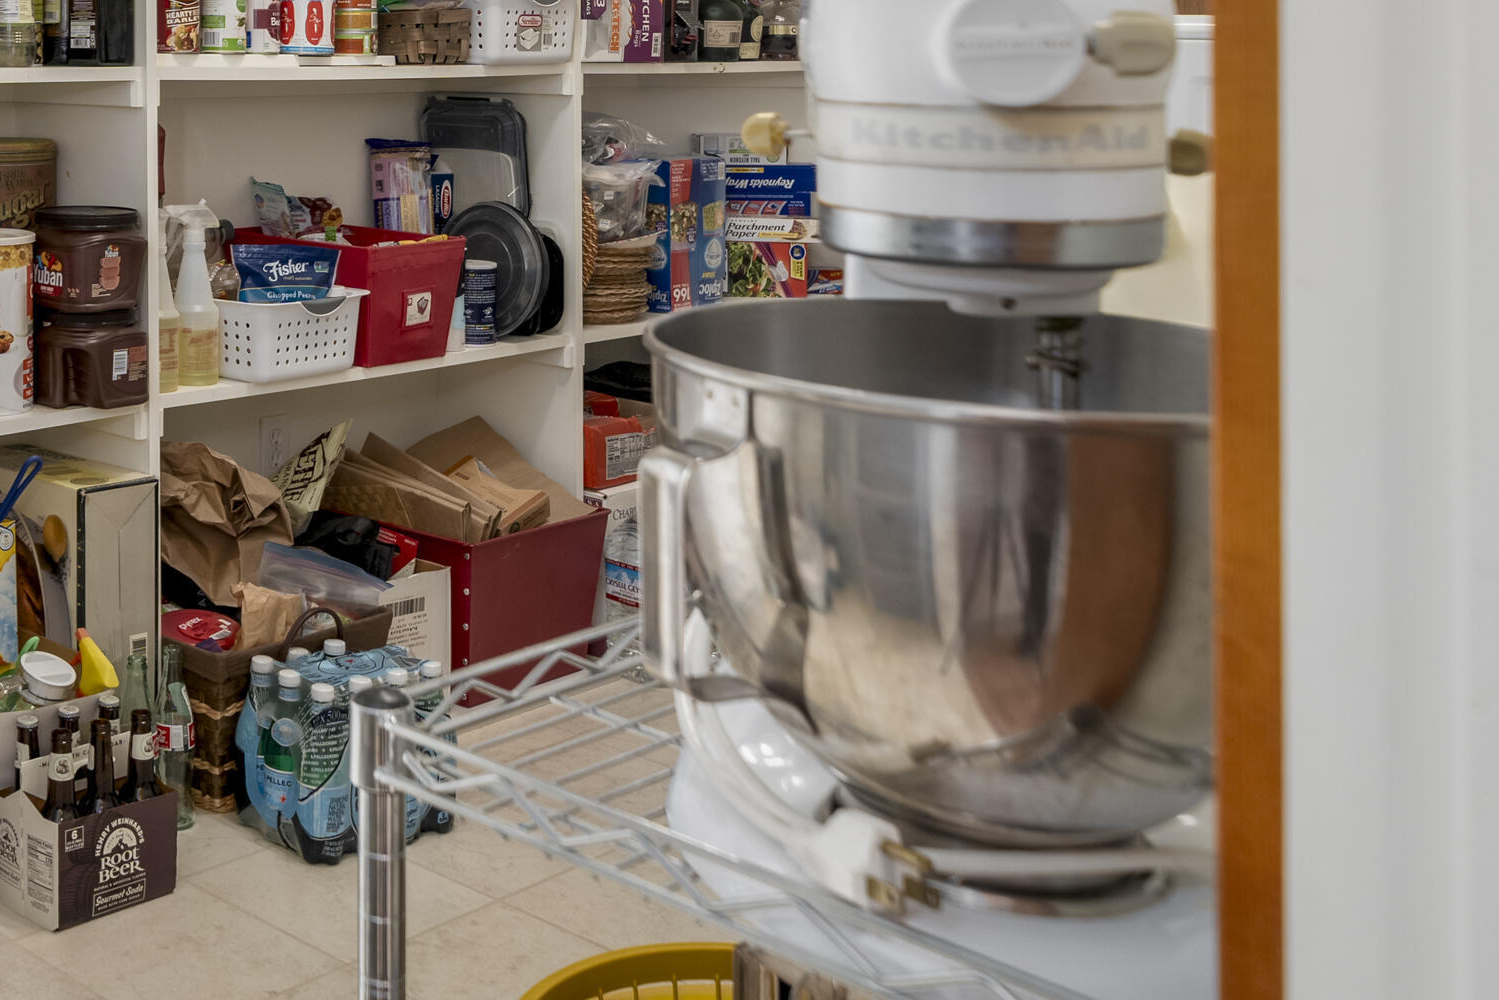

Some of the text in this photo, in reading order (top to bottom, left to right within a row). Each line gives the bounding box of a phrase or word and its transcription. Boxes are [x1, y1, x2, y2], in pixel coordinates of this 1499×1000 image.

[850, 117, 1151, 153] KitchenAid
[749, 178, 796, 189] Reynolds
[725, 229, 757, 239] Paper
[727, 221, 786, 232] Parchment
[32, 265, 64, 287] Yuban
[262, 258, 309, 282] Fisher
[266, 291, 297, 300] Chopped
[672, 286, 691, 302] 166
[698, 280, 722, 297] Ziploc
[71, 829, 78, 840] 6
[94, 817, 145, 857] HENRY WEINHARD'S
[95, 883, 144, 907] Gourmet Soda
